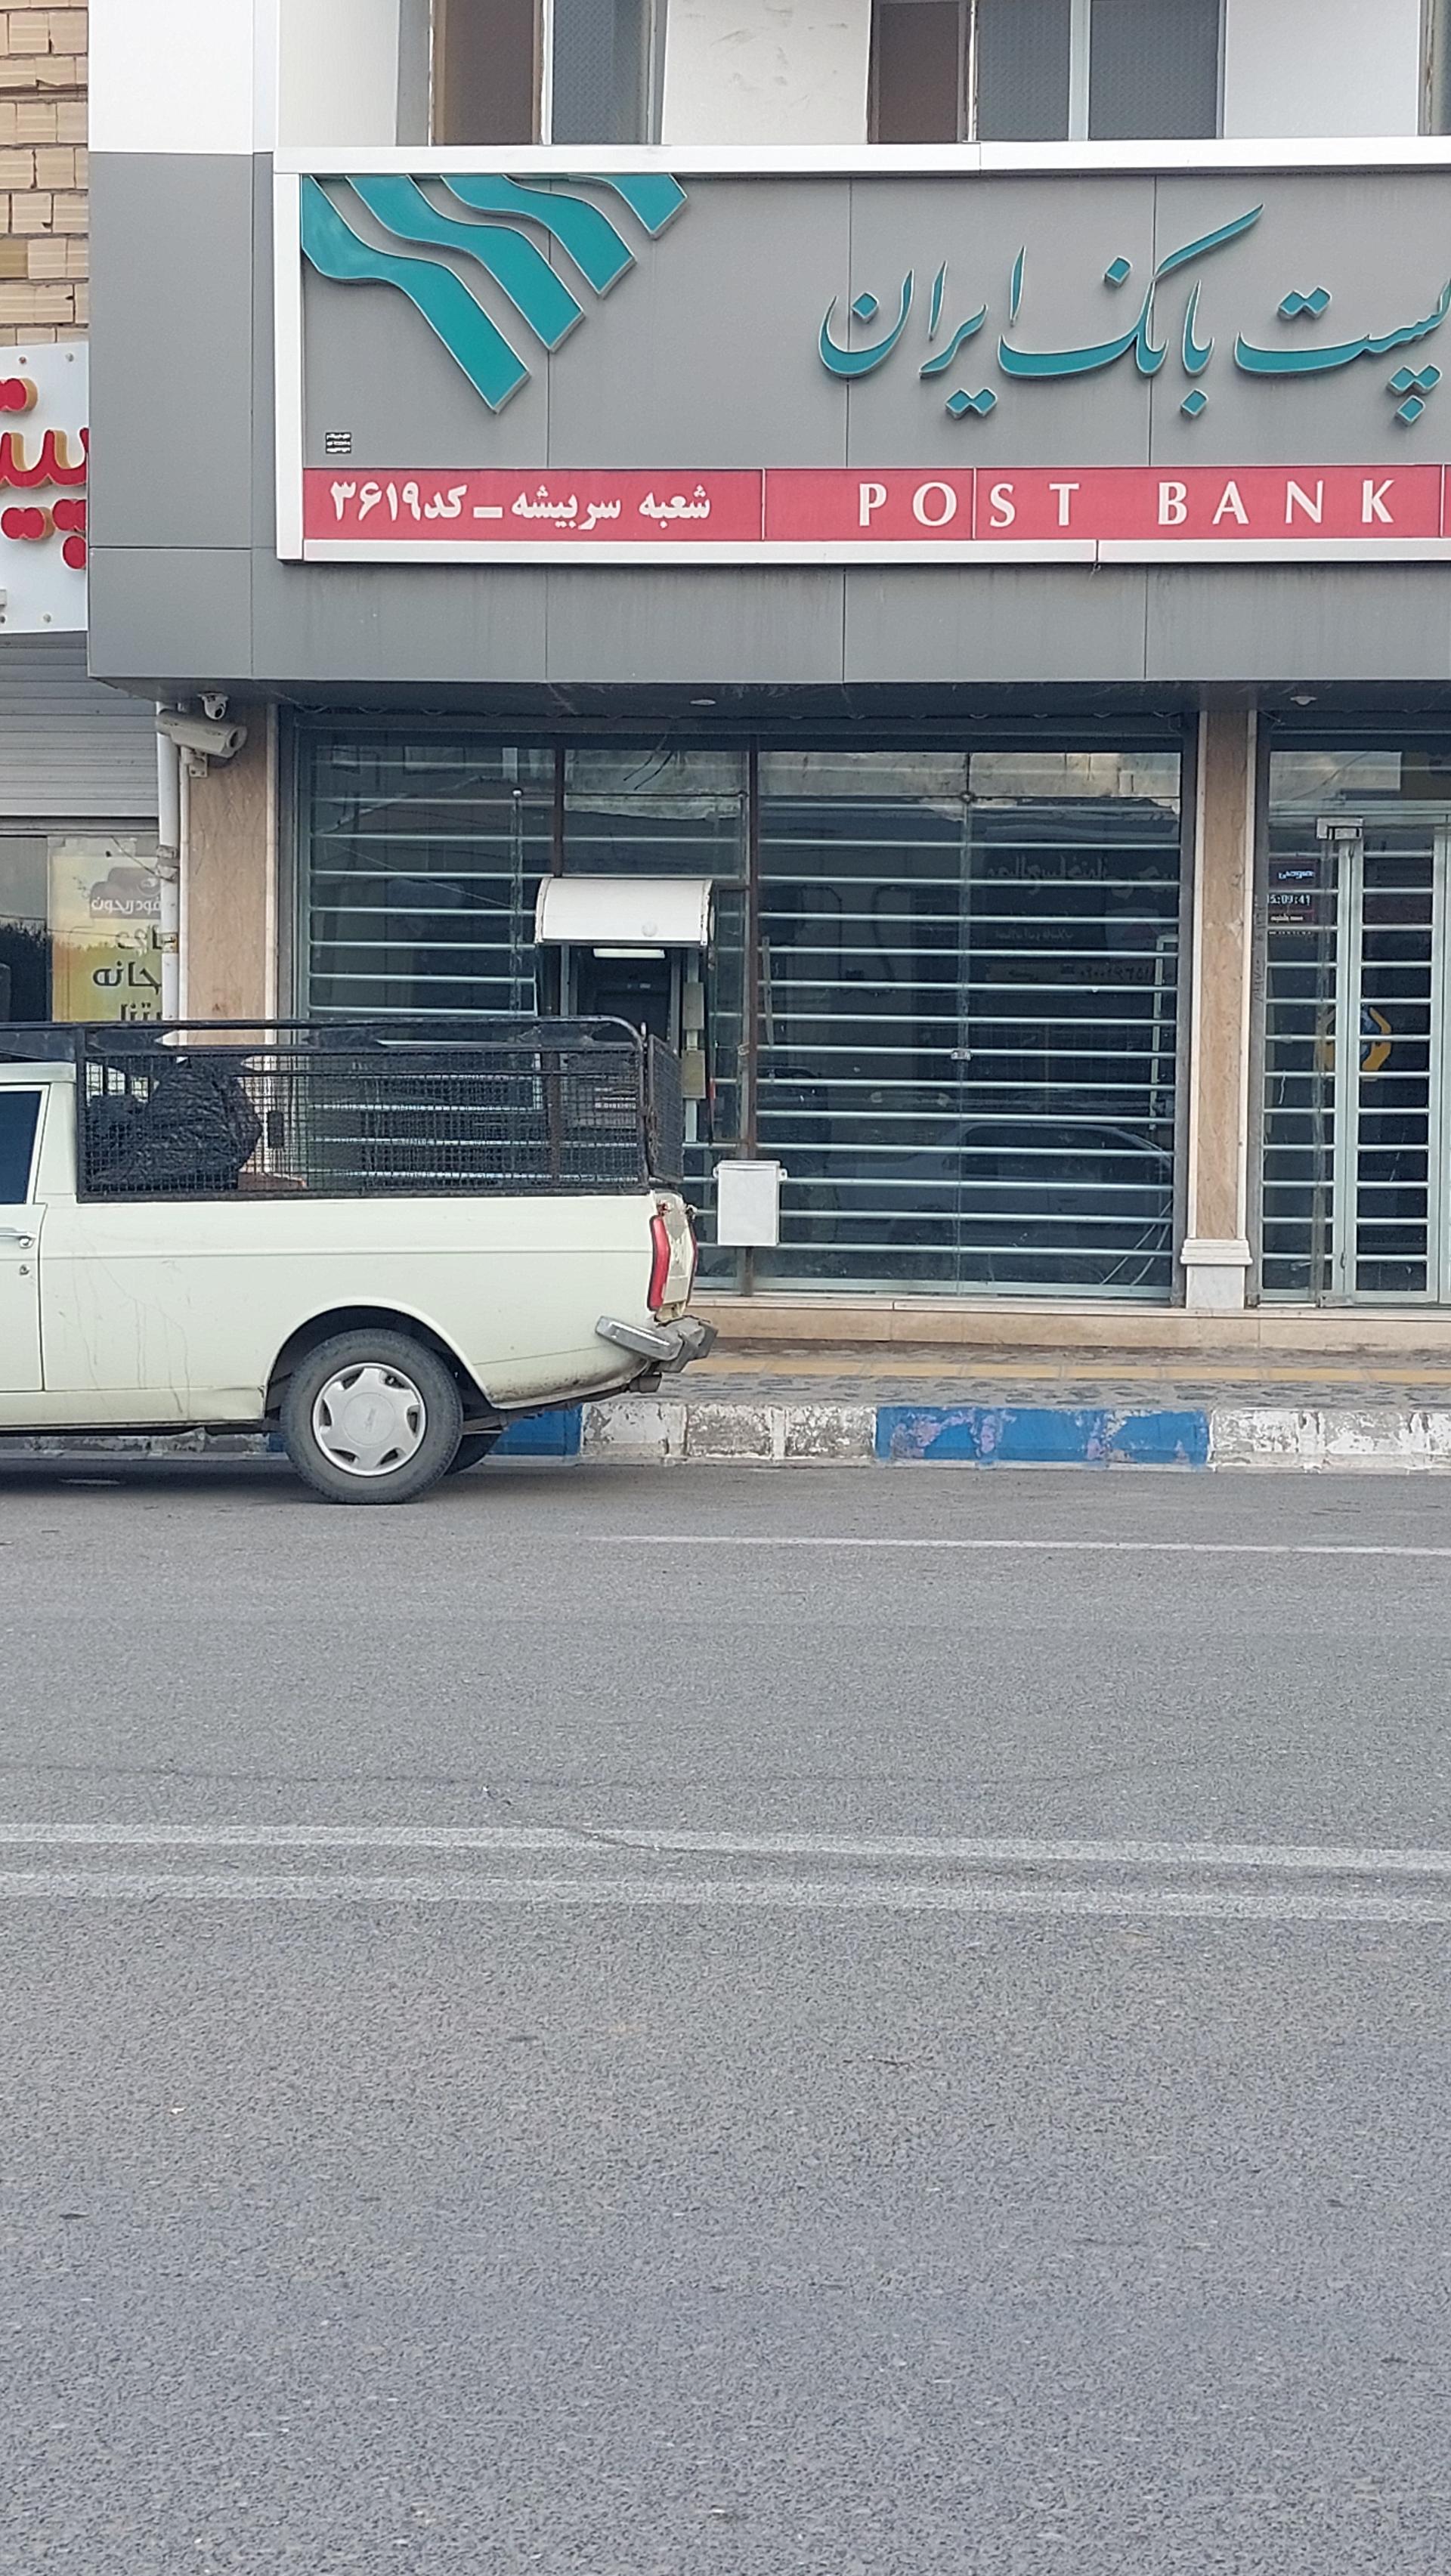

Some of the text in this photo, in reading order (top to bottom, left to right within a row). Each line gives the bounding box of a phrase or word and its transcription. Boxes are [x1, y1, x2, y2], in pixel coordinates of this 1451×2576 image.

[818, 203, 1450, 425] پست بانک ایران
[511, 484, 622, 530] سربیشه
[637, 484, 712, 528] شعبه
[858, 479, 1395, 528] POST BANK
